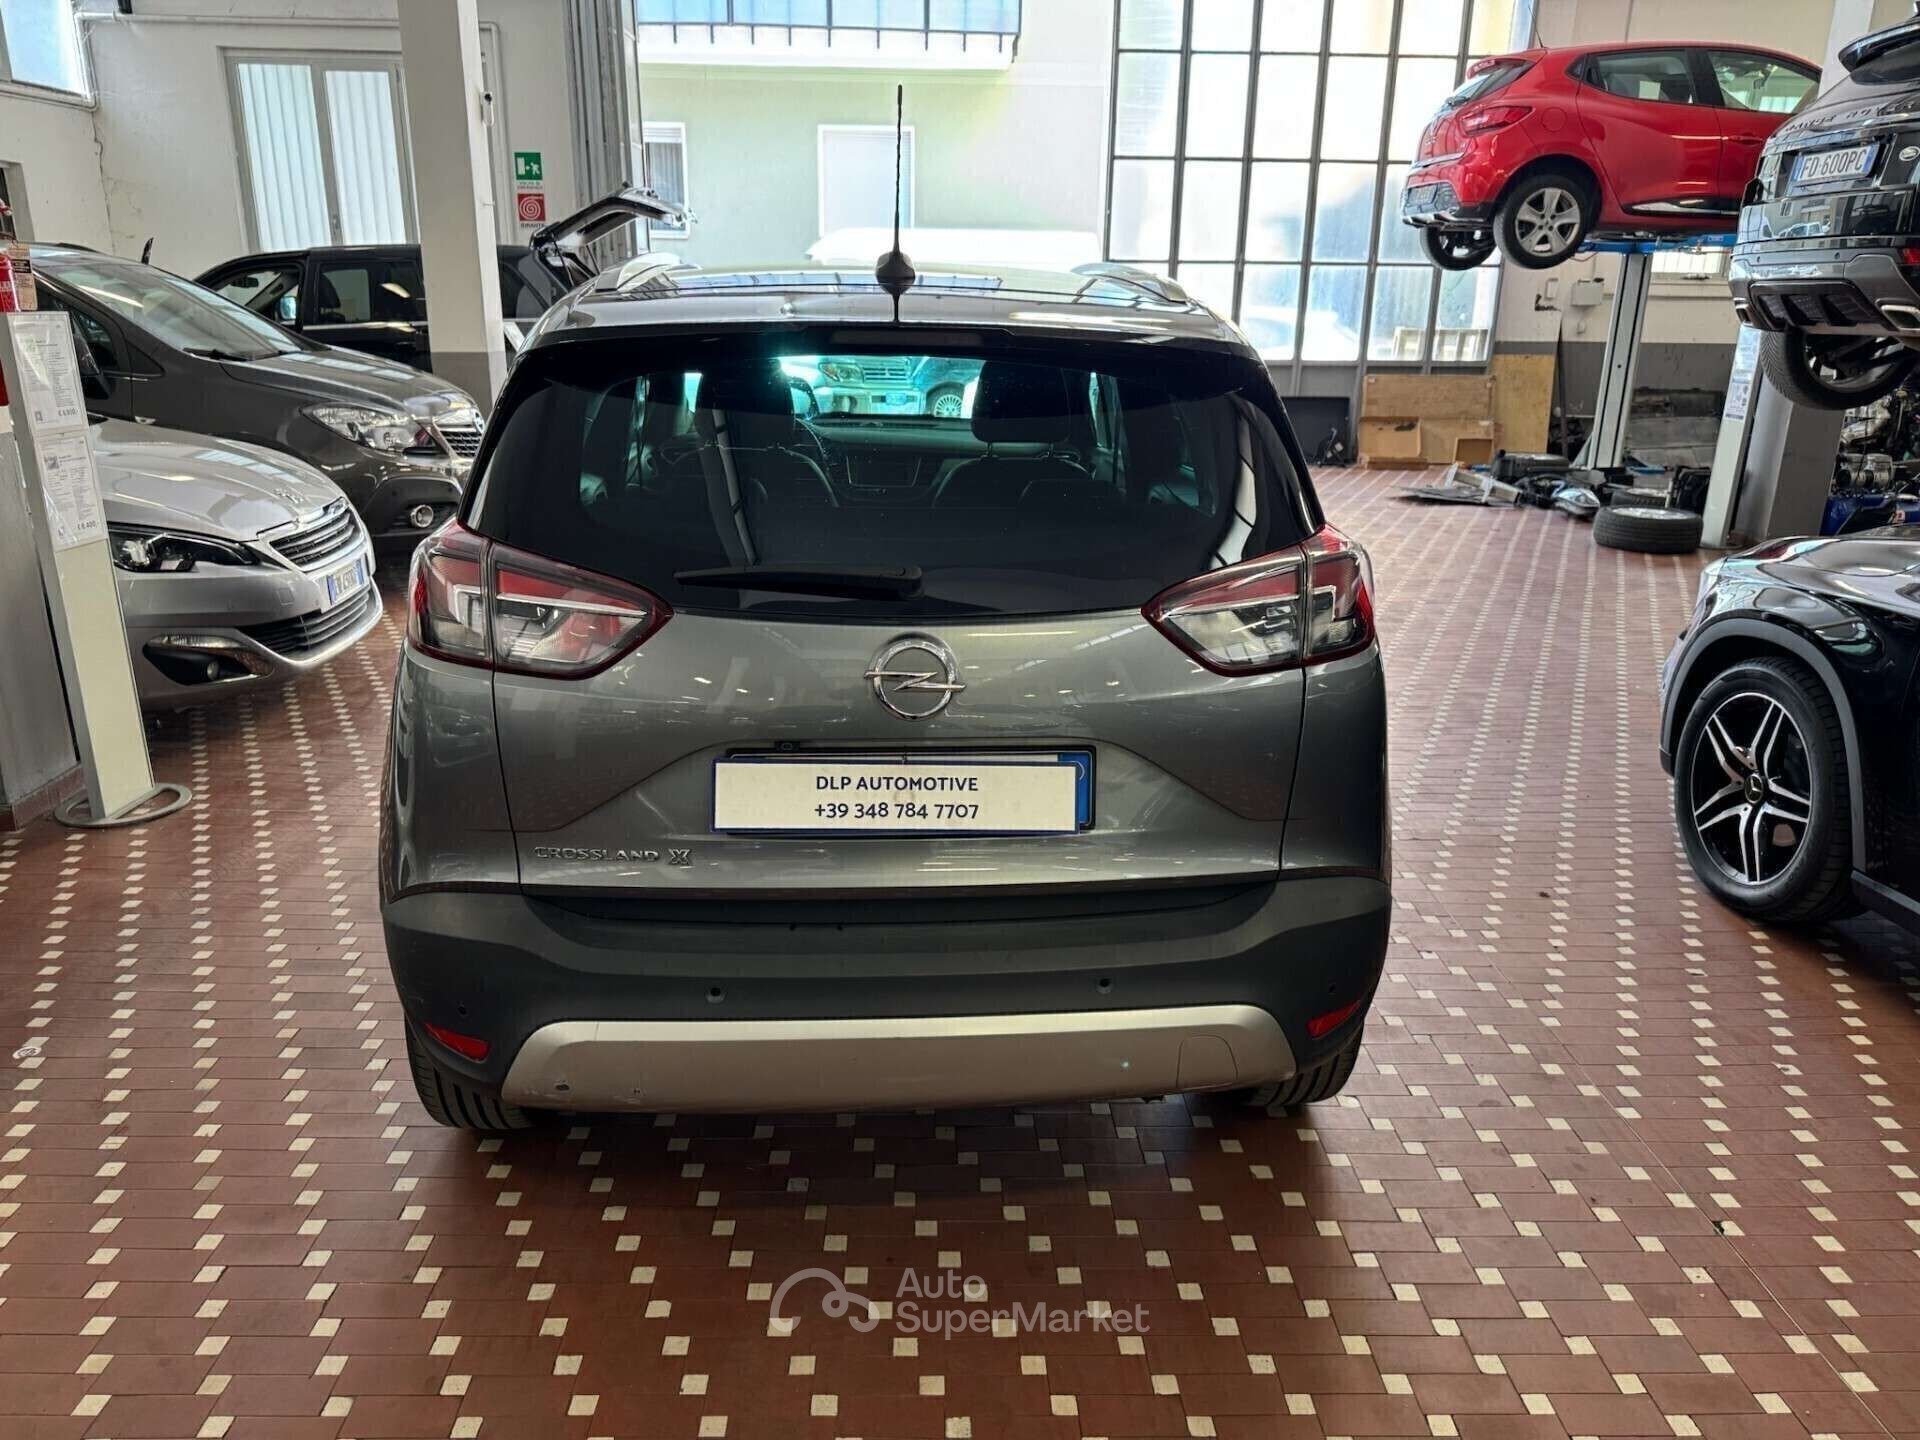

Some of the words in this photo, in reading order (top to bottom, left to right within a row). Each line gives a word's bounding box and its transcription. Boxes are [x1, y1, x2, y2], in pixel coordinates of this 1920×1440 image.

[816, 775, 851, 791] DLP
[856, 776, 978, 792] AUTOMOTIVE
[814, 803, 849, 818] +39
[854, 802, 889, 818] 348
[894, 803, 929, 819] 784
[934, 804, 979, 819] 7707
[534, 847, 660, 861] CROSSLAND
[668, 848, 692, 865] X
